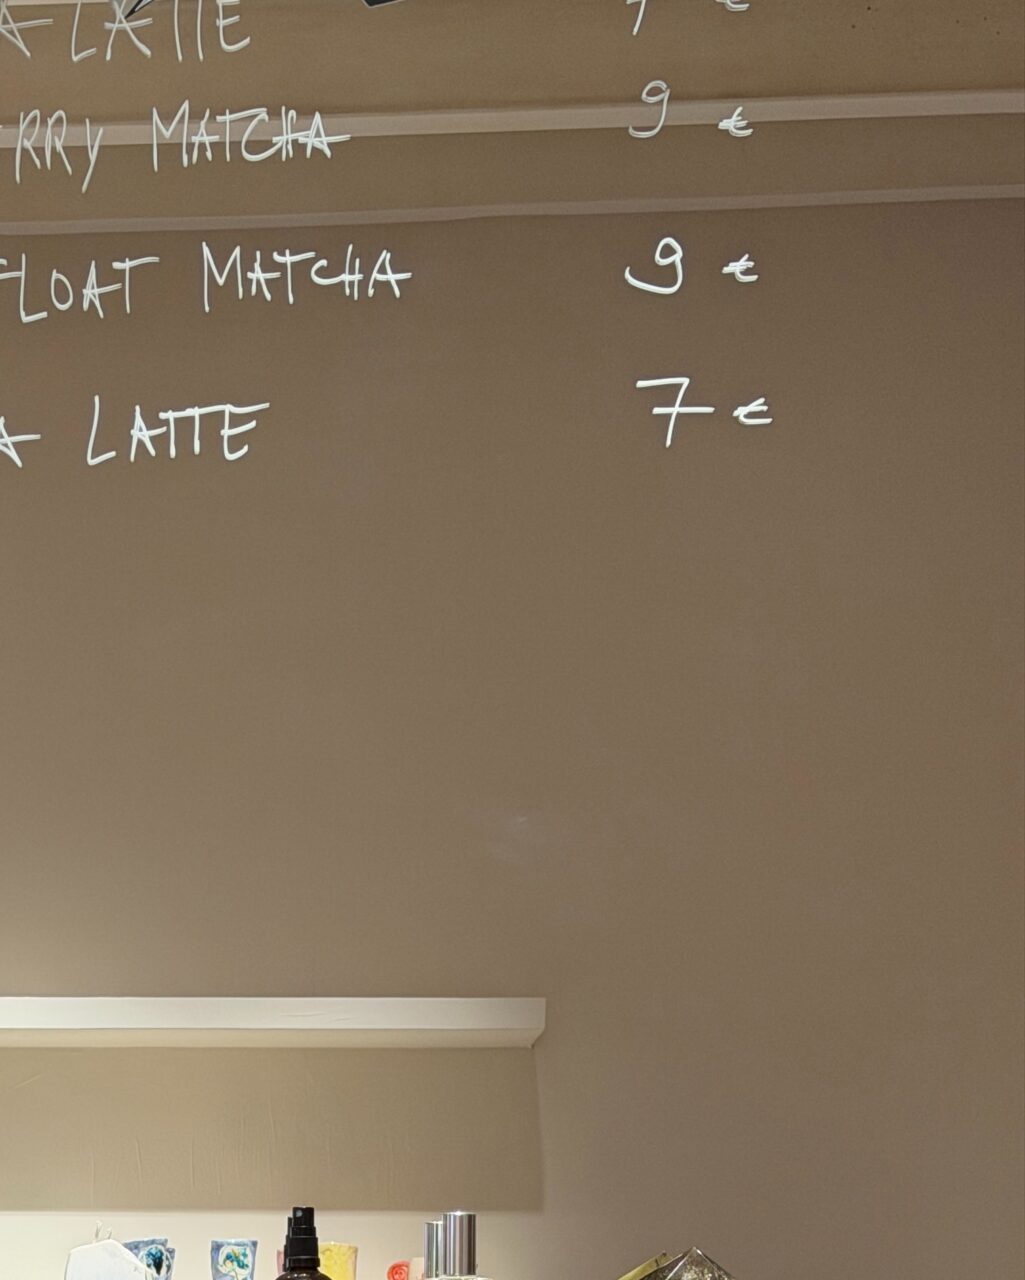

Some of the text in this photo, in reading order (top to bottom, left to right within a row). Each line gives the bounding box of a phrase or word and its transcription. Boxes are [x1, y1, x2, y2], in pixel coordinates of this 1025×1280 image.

[151, 99, 351, 172] MATCHA
[628, 79, 671, 138] 9
[201, 241, 413, 313] MATCHA
[624, 236, 683, 295] 9
[86, 394, 271, 466] LATTE
[636, 376, 773, 448] 7 €
